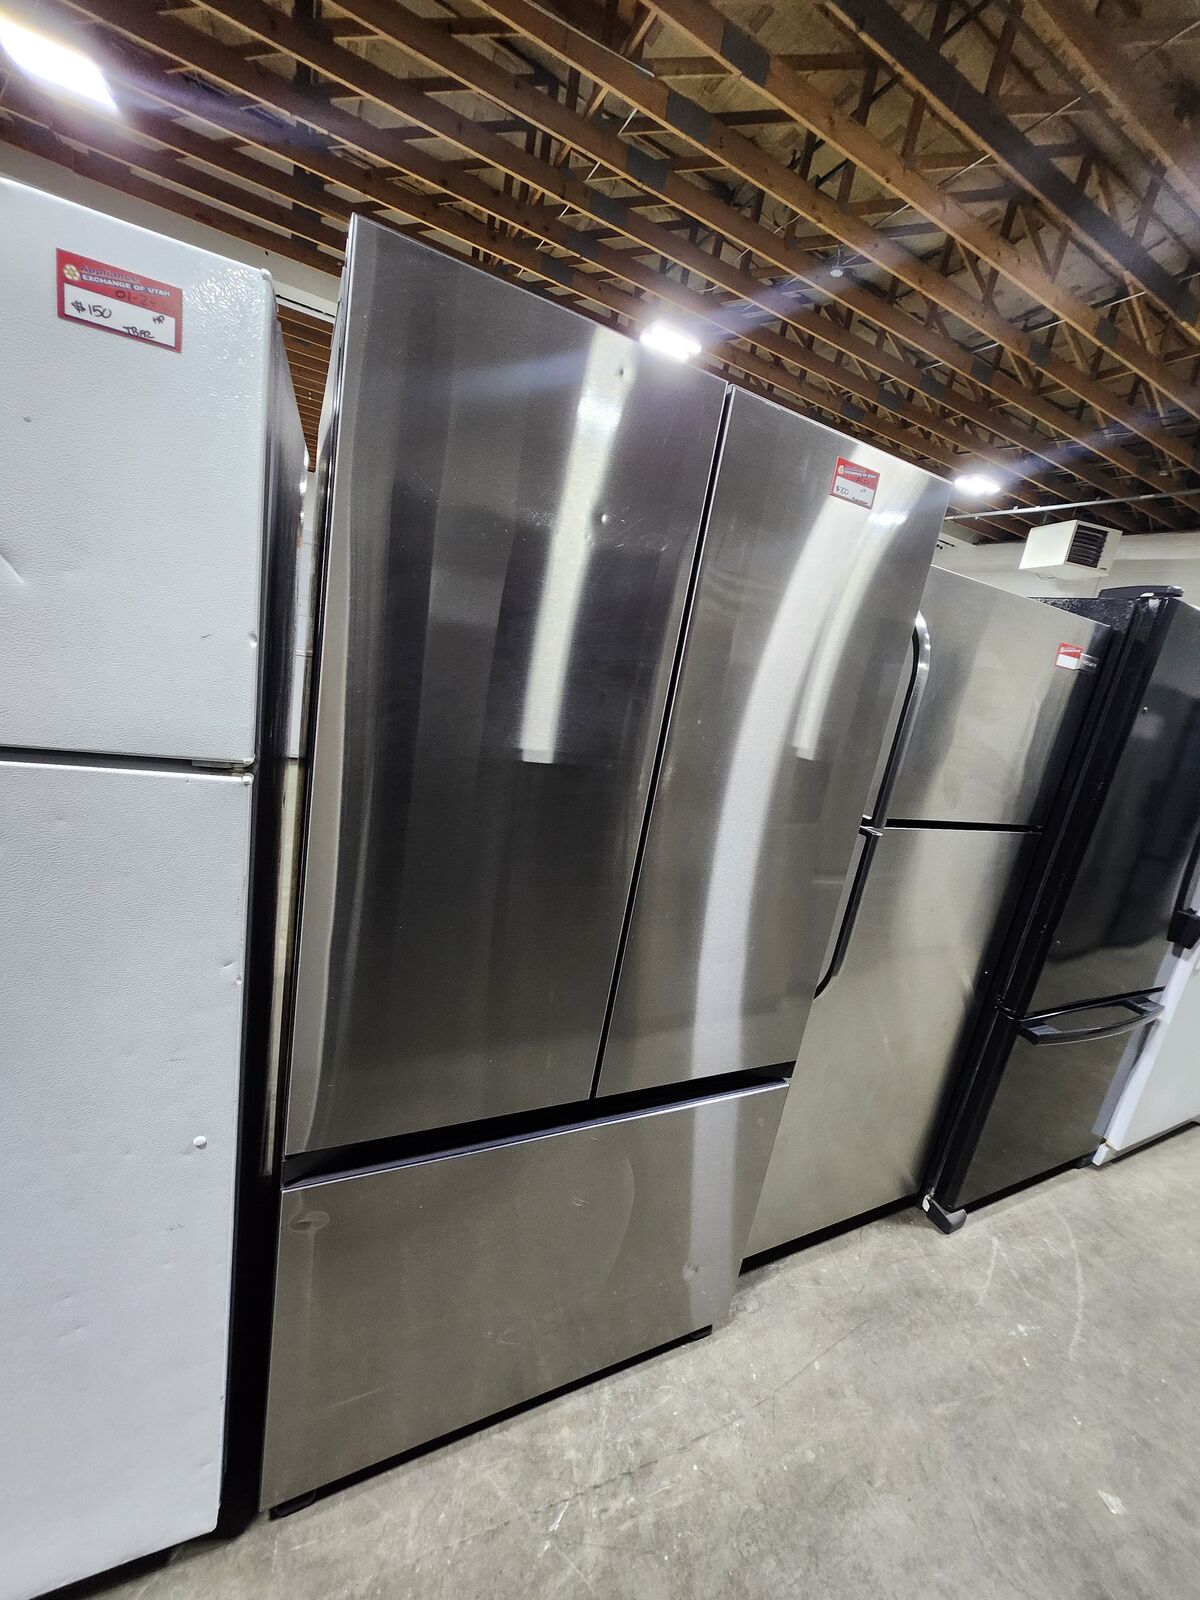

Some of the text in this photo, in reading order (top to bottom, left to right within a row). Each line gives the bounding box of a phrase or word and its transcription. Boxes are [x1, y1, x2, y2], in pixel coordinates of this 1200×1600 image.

[81, 275, 171, 297] EXCHANGE OF UTAH
